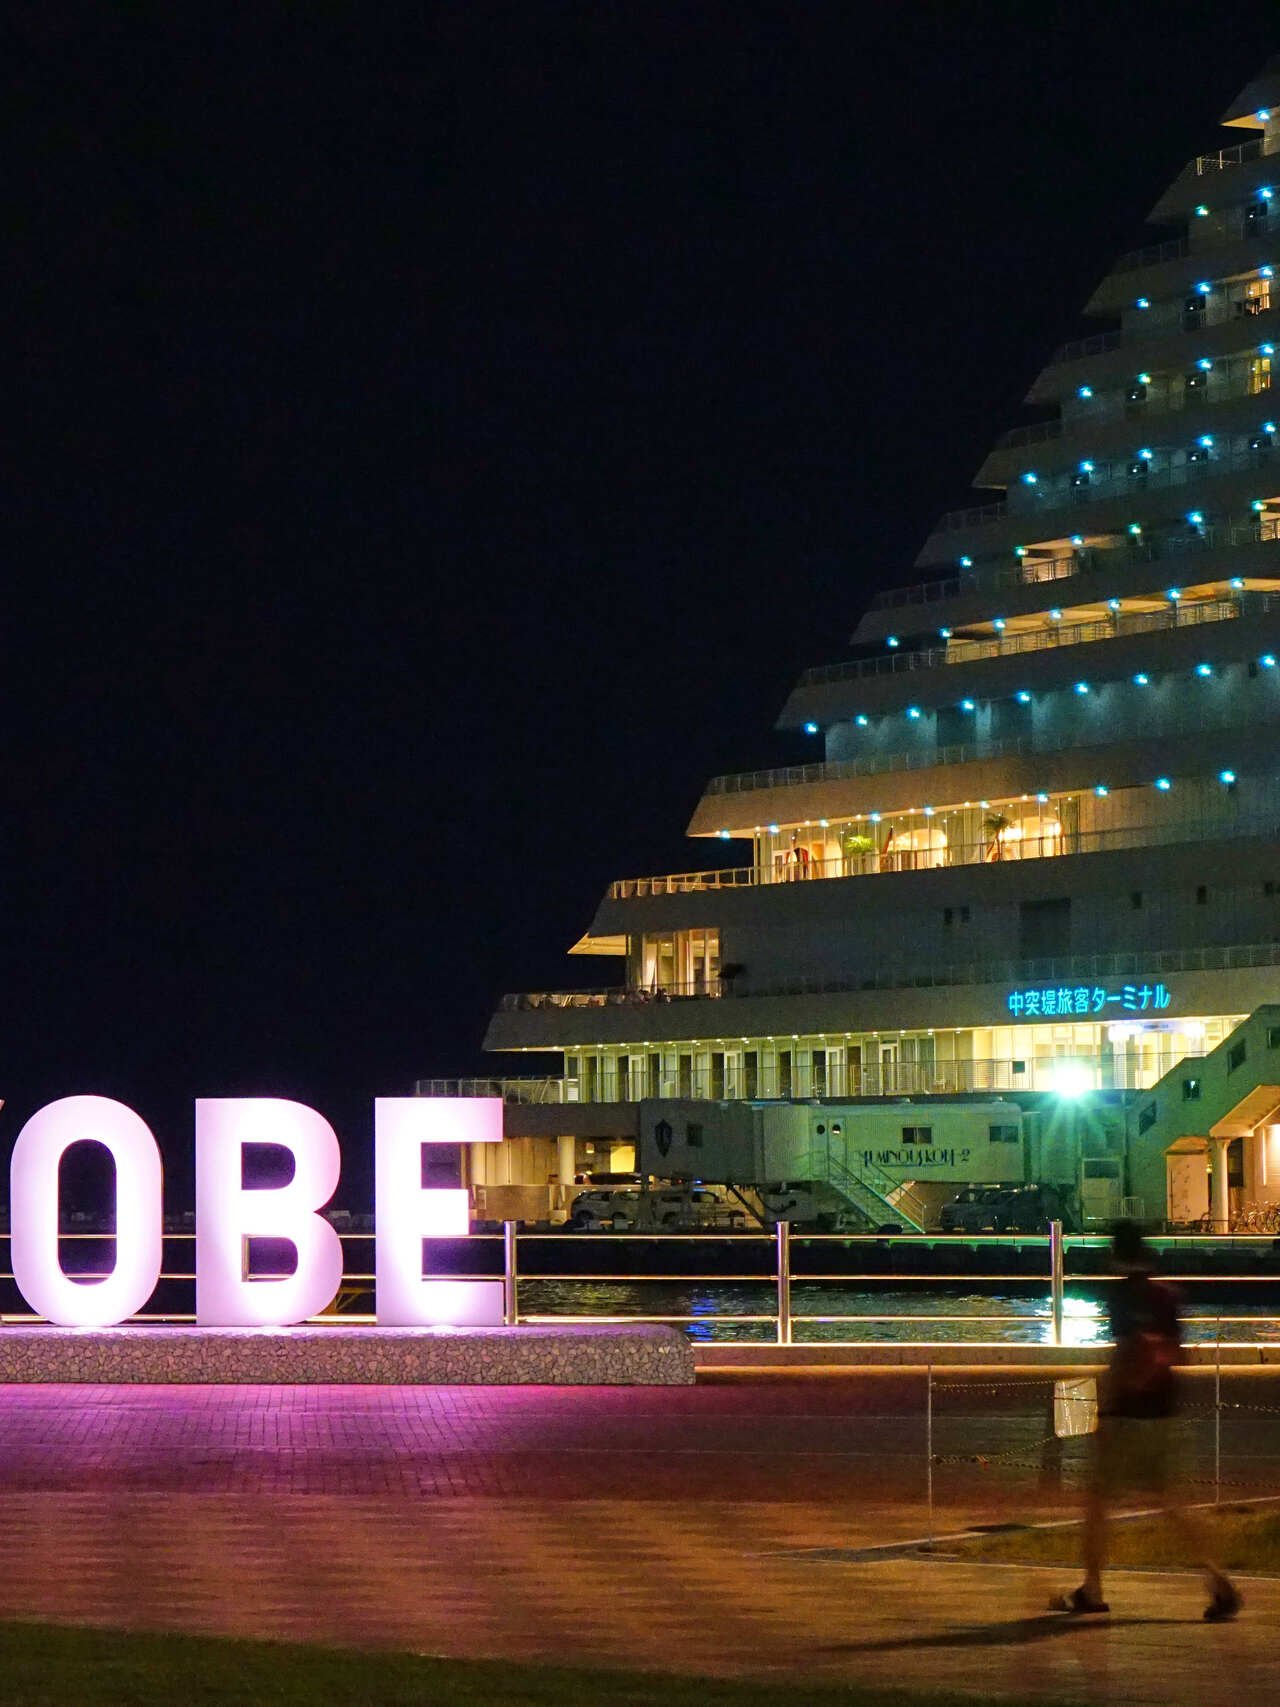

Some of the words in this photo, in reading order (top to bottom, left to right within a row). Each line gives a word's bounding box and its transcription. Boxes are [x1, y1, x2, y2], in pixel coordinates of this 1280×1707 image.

[1008, 984, 1171, 1016] 中突堤旅客ターミナル
